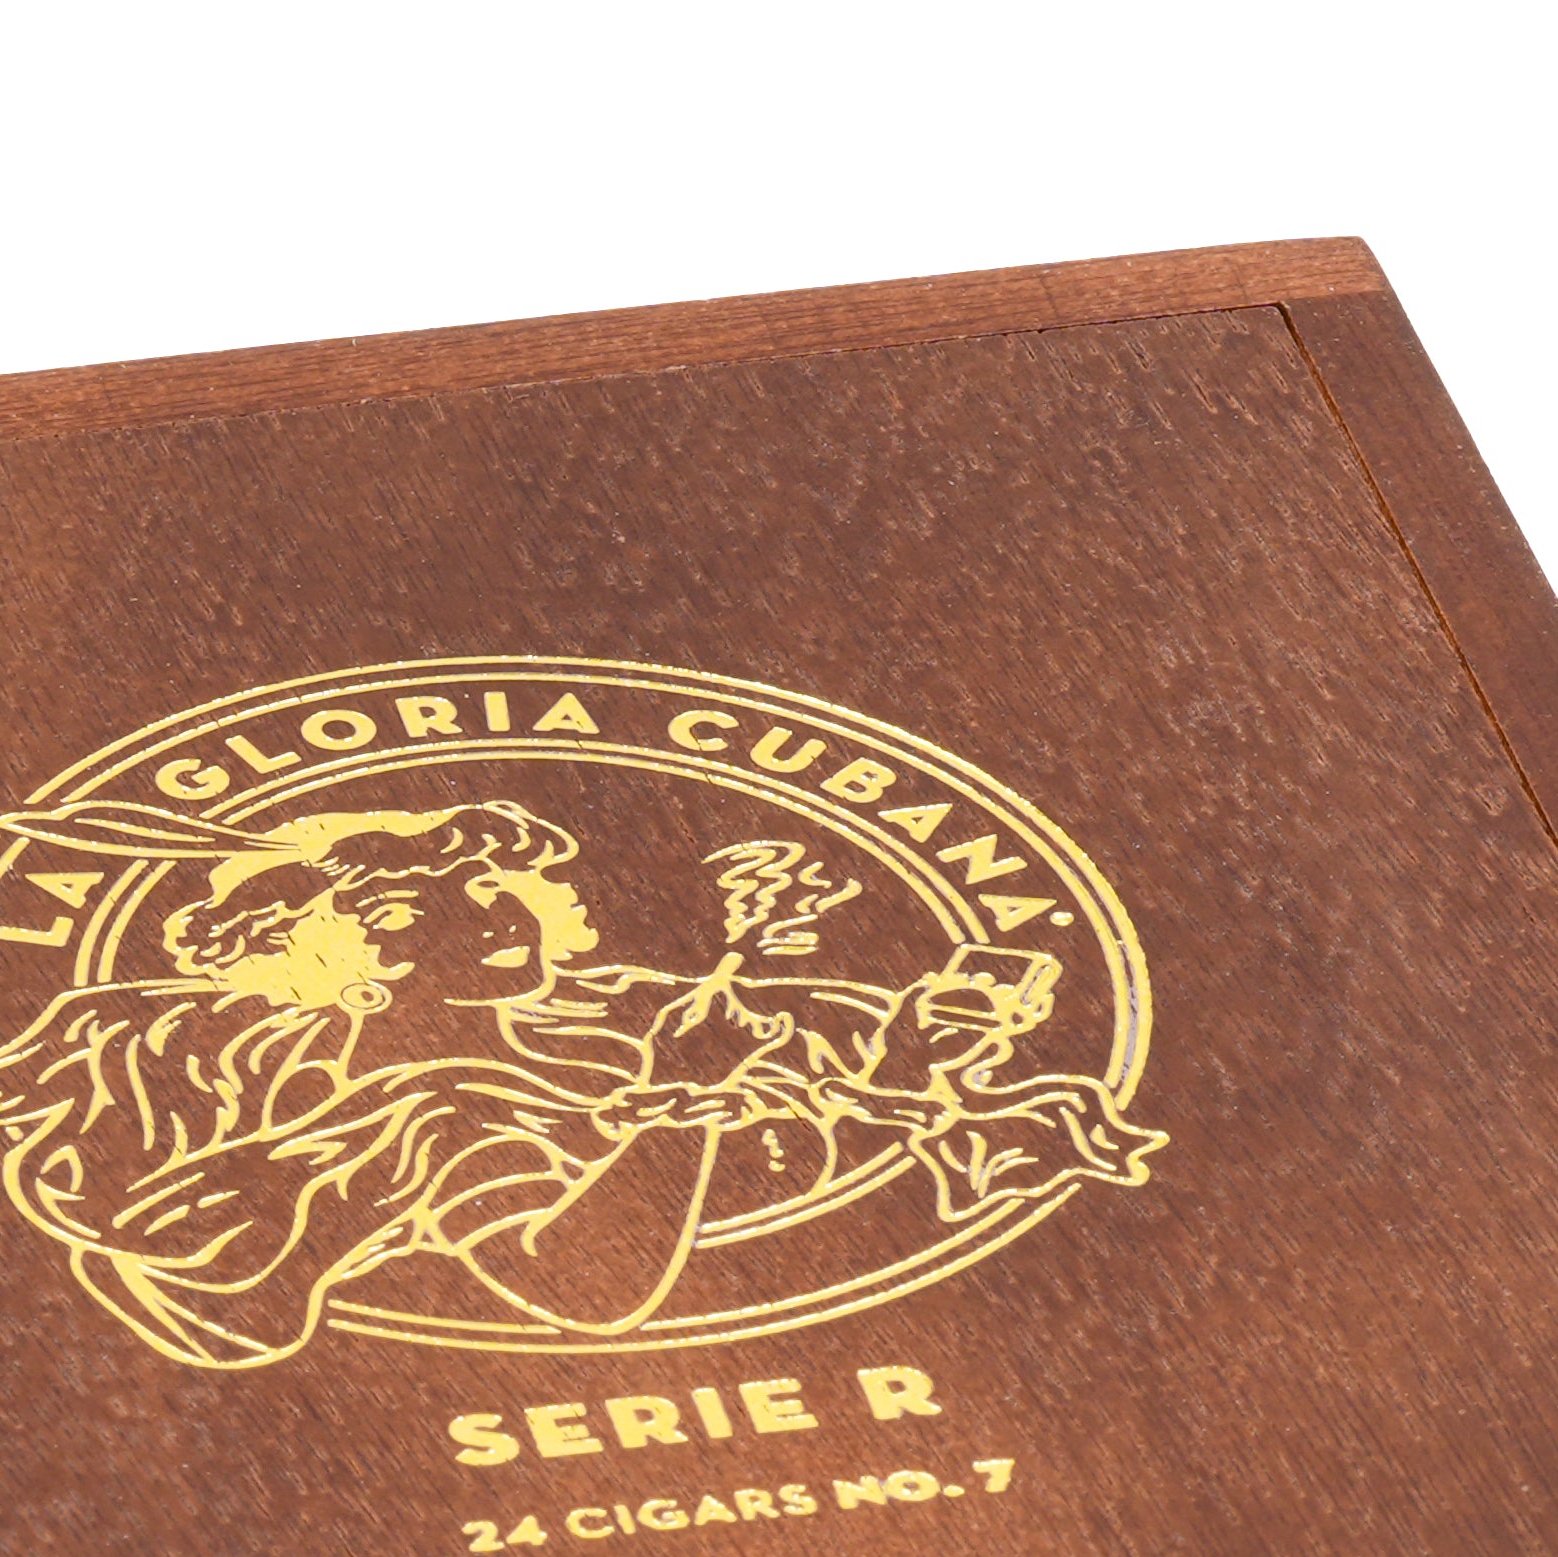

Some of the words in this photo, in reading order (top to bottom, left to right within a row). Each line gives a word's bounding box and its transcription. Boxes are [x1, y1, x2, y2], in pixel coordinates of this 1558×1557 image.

[155, 692, 599, 800] GLORIA
[448, 1377, 819, 1466] SERIE
[856, 1365, 942, 1421] R
[461, 1515, 548, 1553] 24
[565, 1484, 818, 1539] CIGARS
[832, 1469, 965, 1509] NO.
[972, 1458, 1015, 1493] 7
